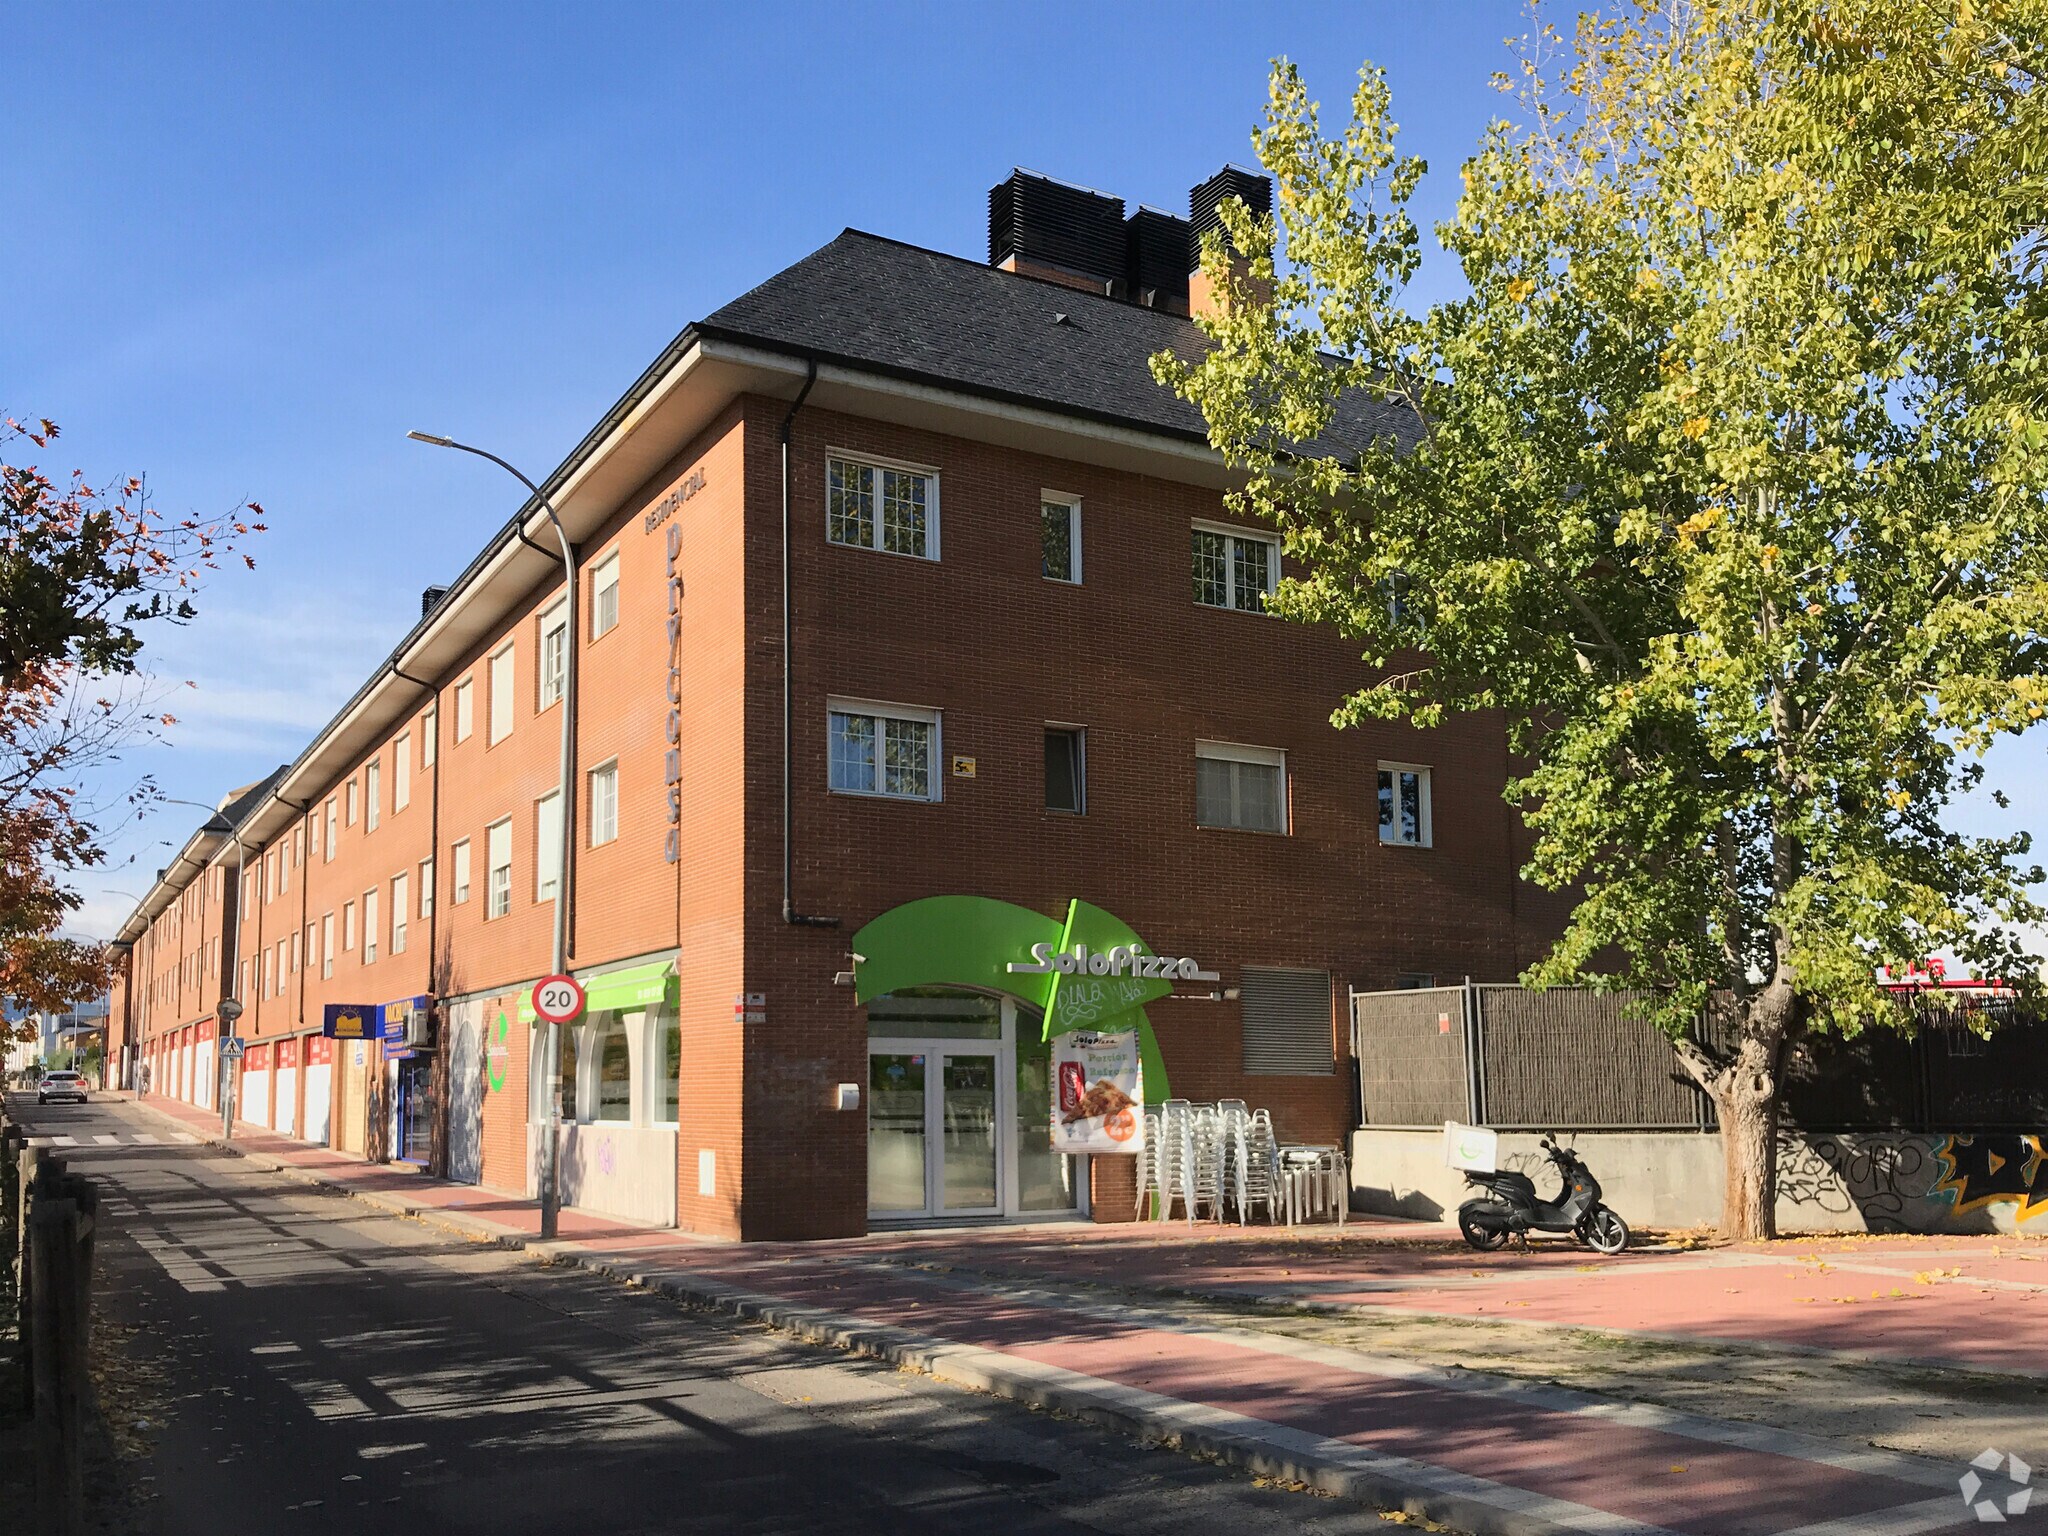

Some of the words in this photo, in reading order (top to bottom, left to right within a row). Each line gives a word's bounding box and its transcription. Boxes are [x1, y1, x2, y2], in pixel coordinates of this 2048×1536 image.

[645, 467, 706, 535] RESIDENCIAL
[1007, 942, 1220, 981] SoloPizza
[544, 990, 571, 1008] 20
[1089, 1067, 1135, 1077] Refreco
